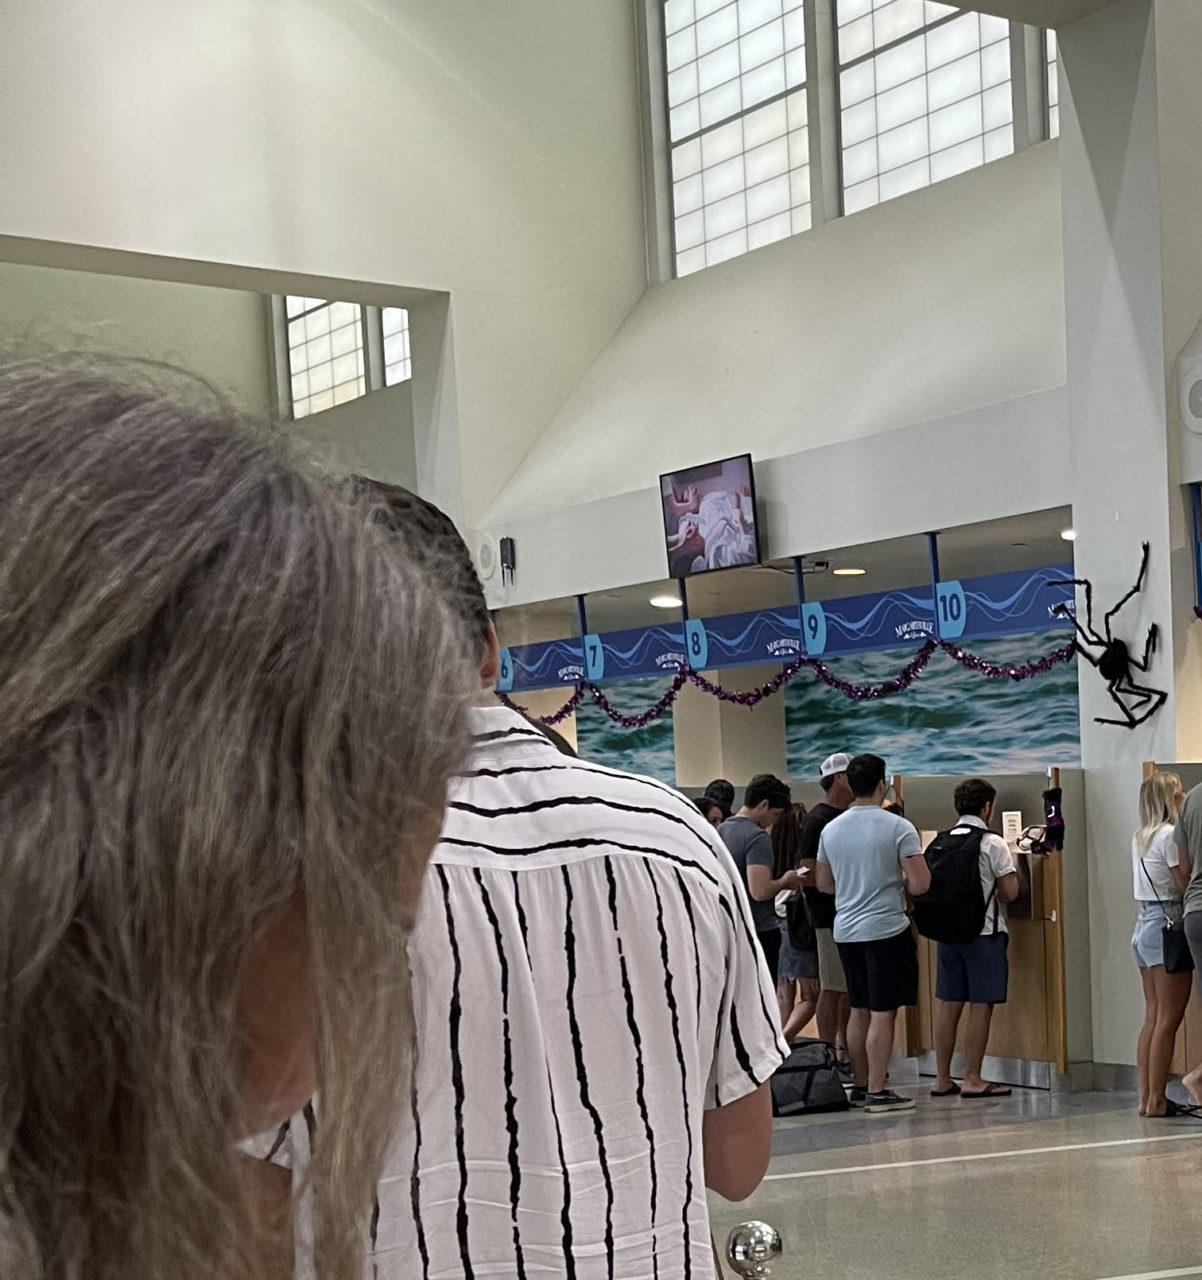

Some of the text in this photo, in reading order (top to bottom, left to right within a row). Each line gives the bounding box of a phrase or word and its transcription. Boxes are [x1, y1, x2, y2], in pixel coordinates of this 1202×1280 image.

[939, 593, 961, 622] 10
[807, 614, 818, 640] 9
[691, 631, 701, 656] 8
[589, 645, 597, 668] 7
